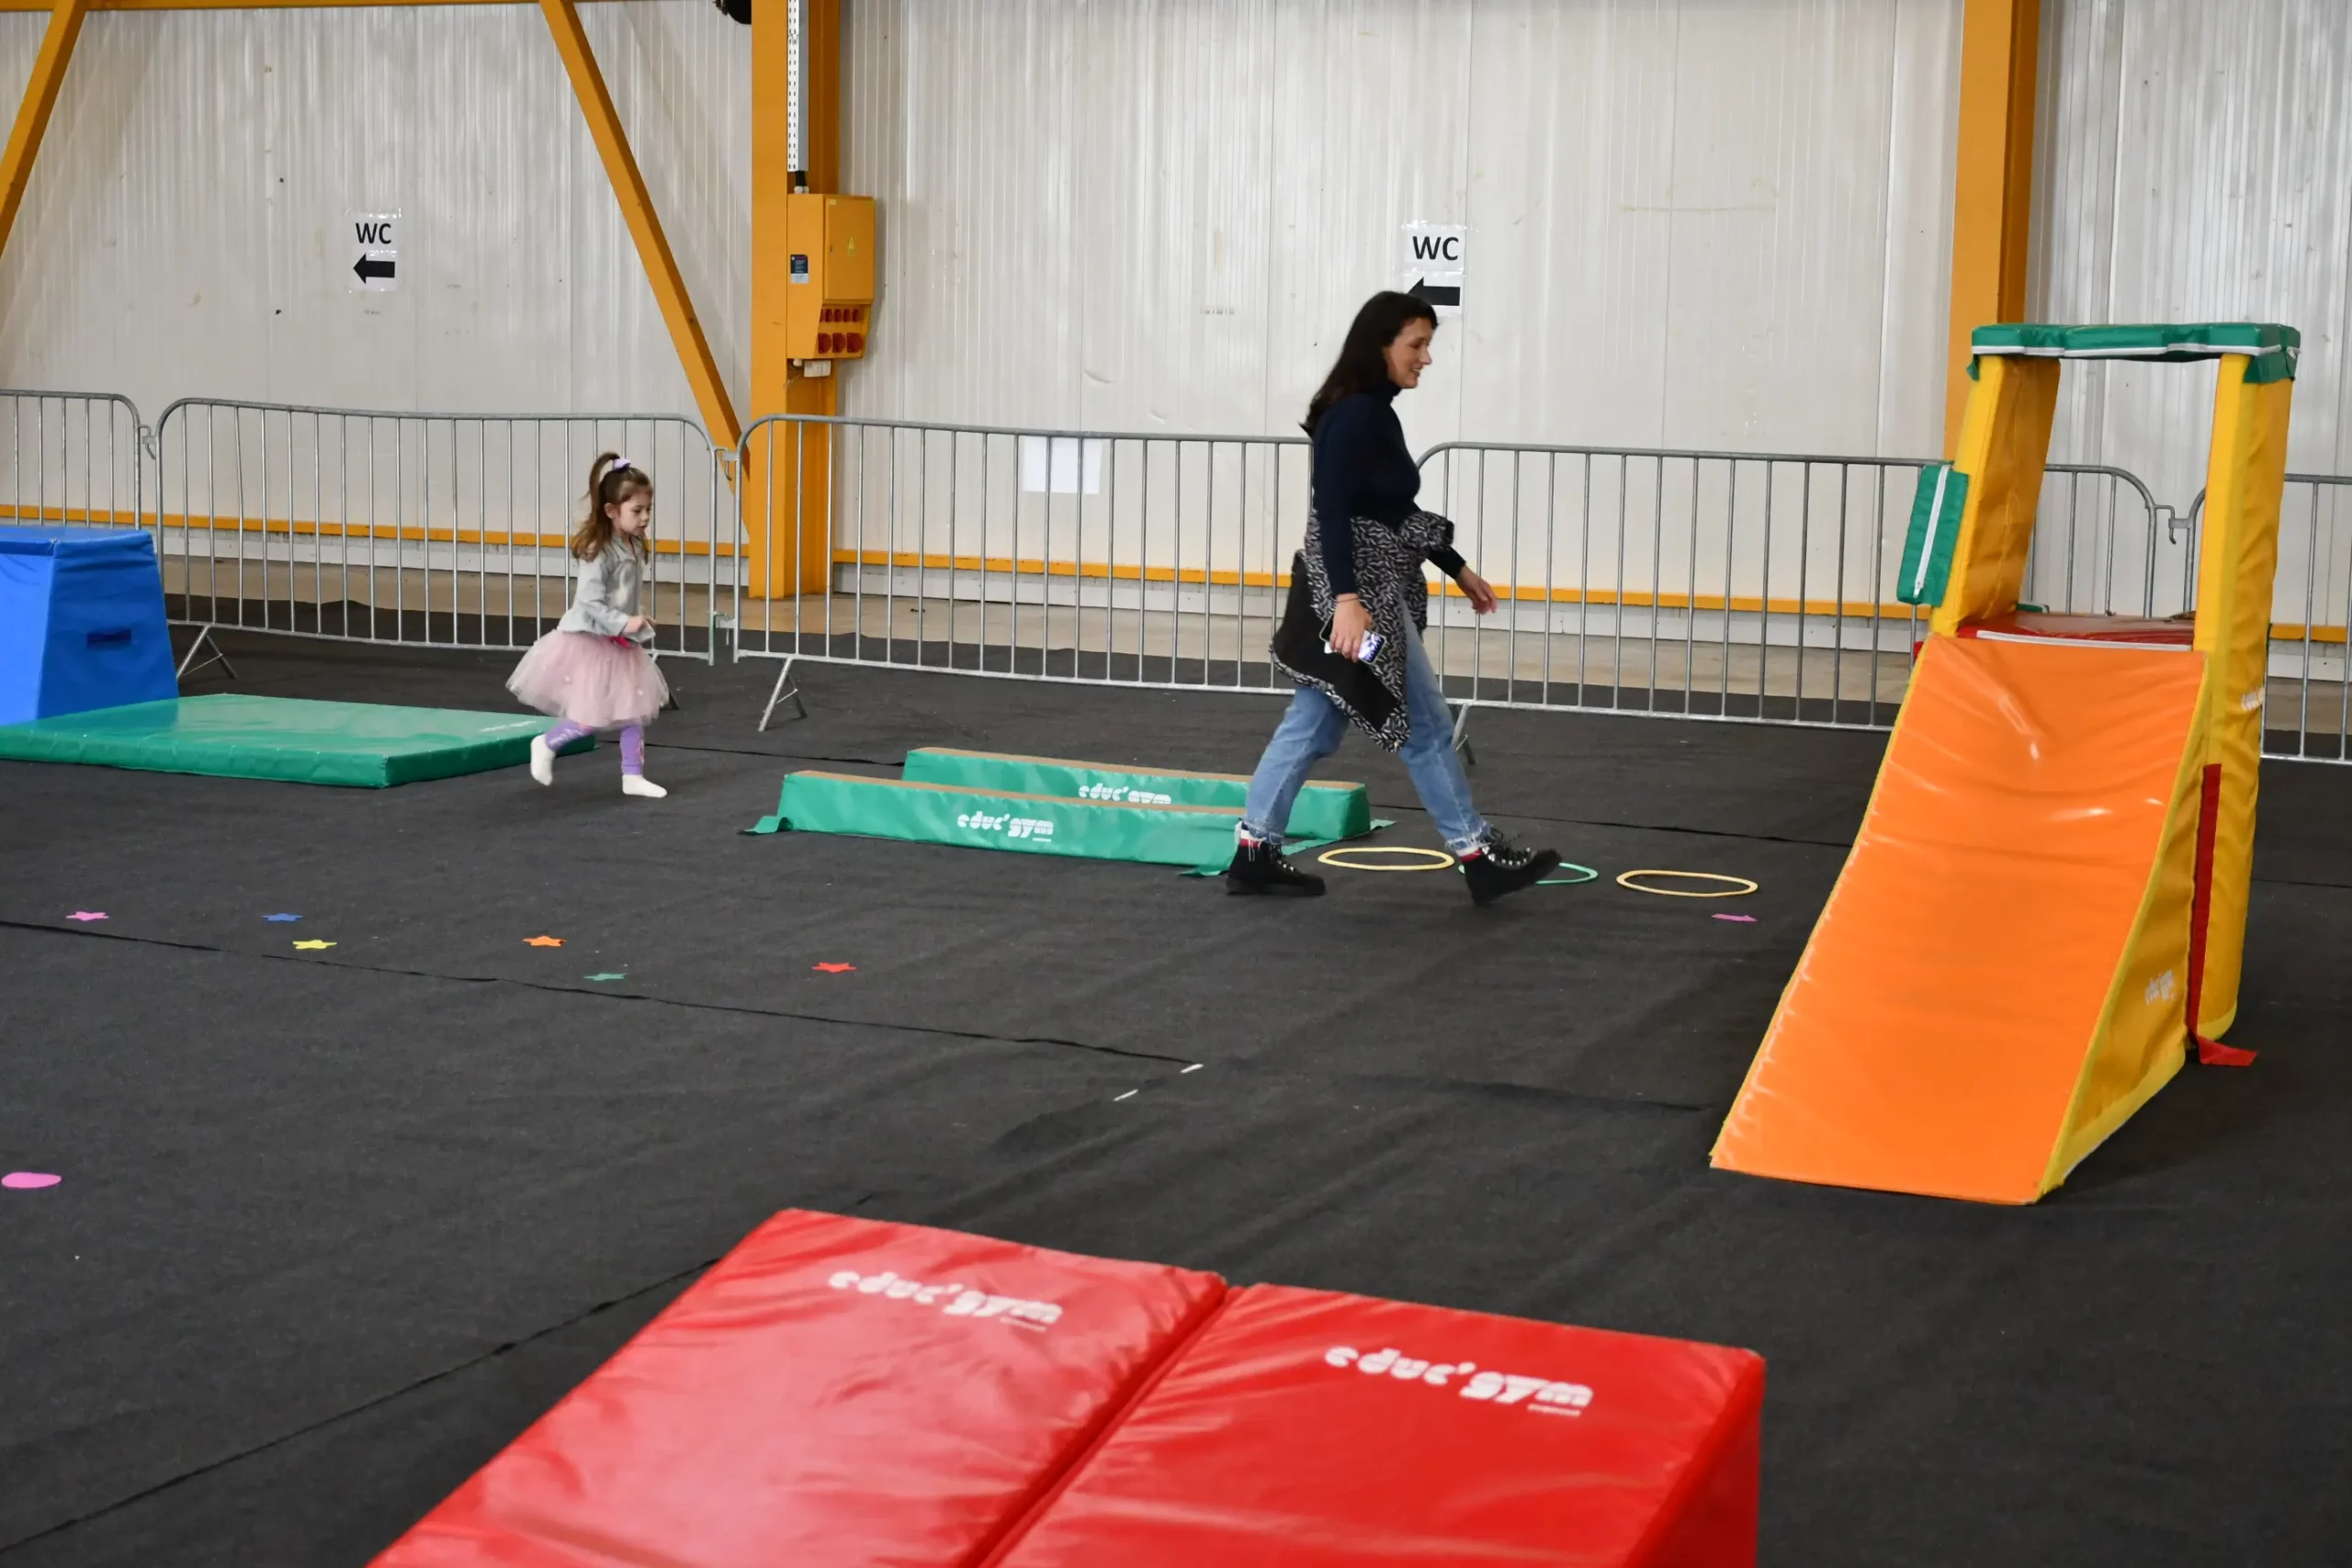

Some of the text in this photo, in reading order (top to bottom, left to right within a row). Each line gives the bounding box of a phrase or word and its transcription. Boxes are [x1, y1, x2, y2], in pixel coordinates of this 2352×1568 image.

[356, 222, 391, 244] WC
[1412, 236, 1459, 261] WC
[1325, 1347, 1594, 1407] educ'gym
